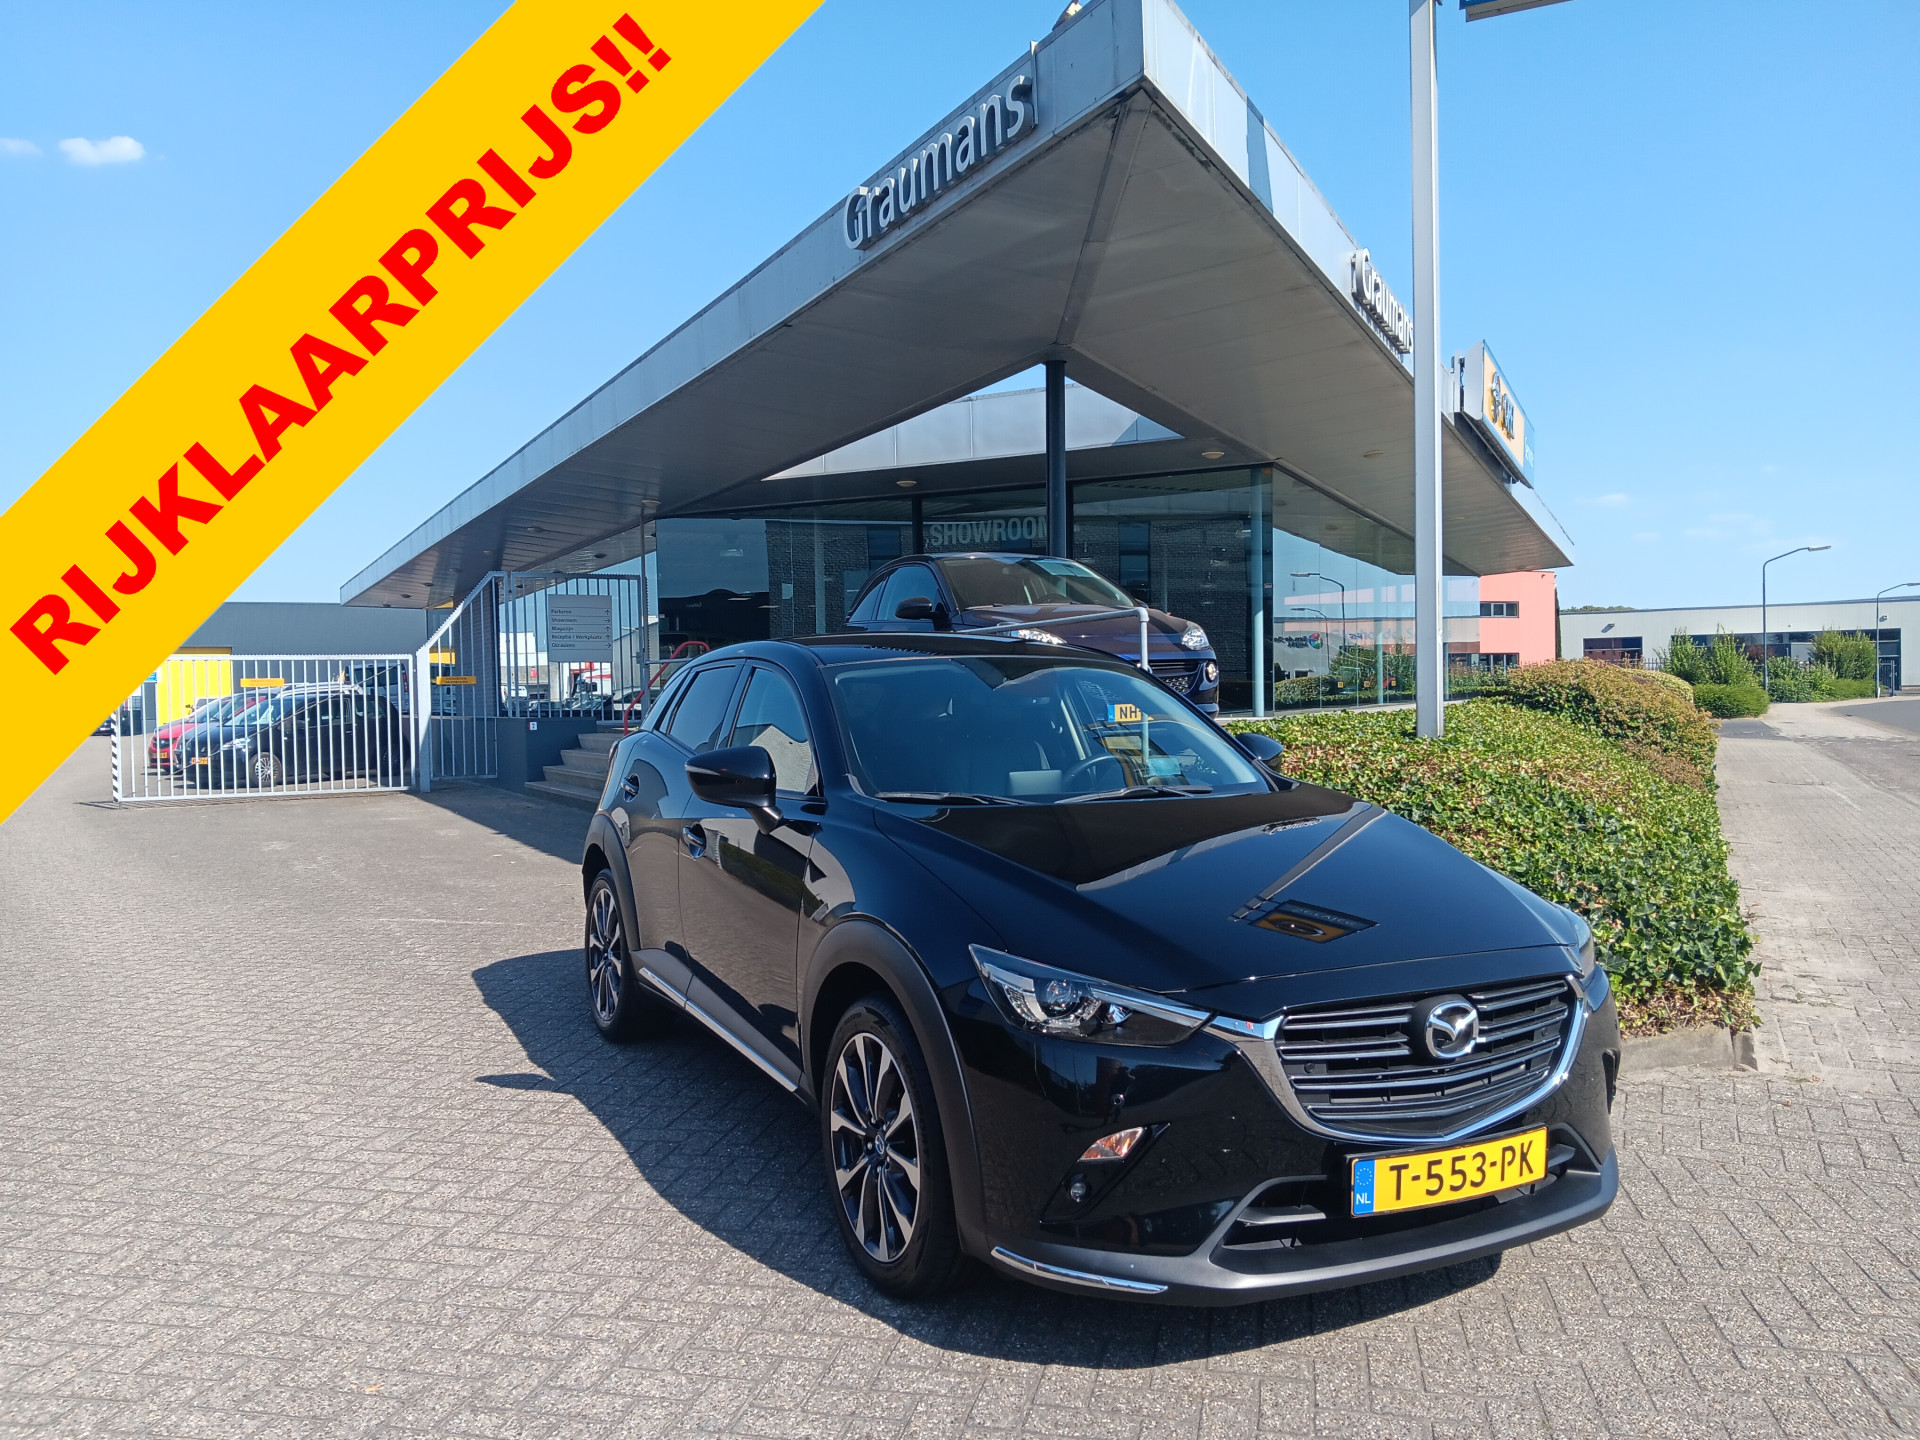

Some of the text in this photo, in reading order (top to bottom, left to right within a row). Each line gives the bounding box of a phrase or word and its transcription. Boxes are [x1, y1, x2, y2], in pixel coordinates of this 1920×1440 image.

[843, 75, 1031, 249] Graumans
[1357, 248, 1413, 354] Graumans
[1355, 1193, 1371, 1205] NL
[1389, 1140, 1534, 1201] T-553-PK
